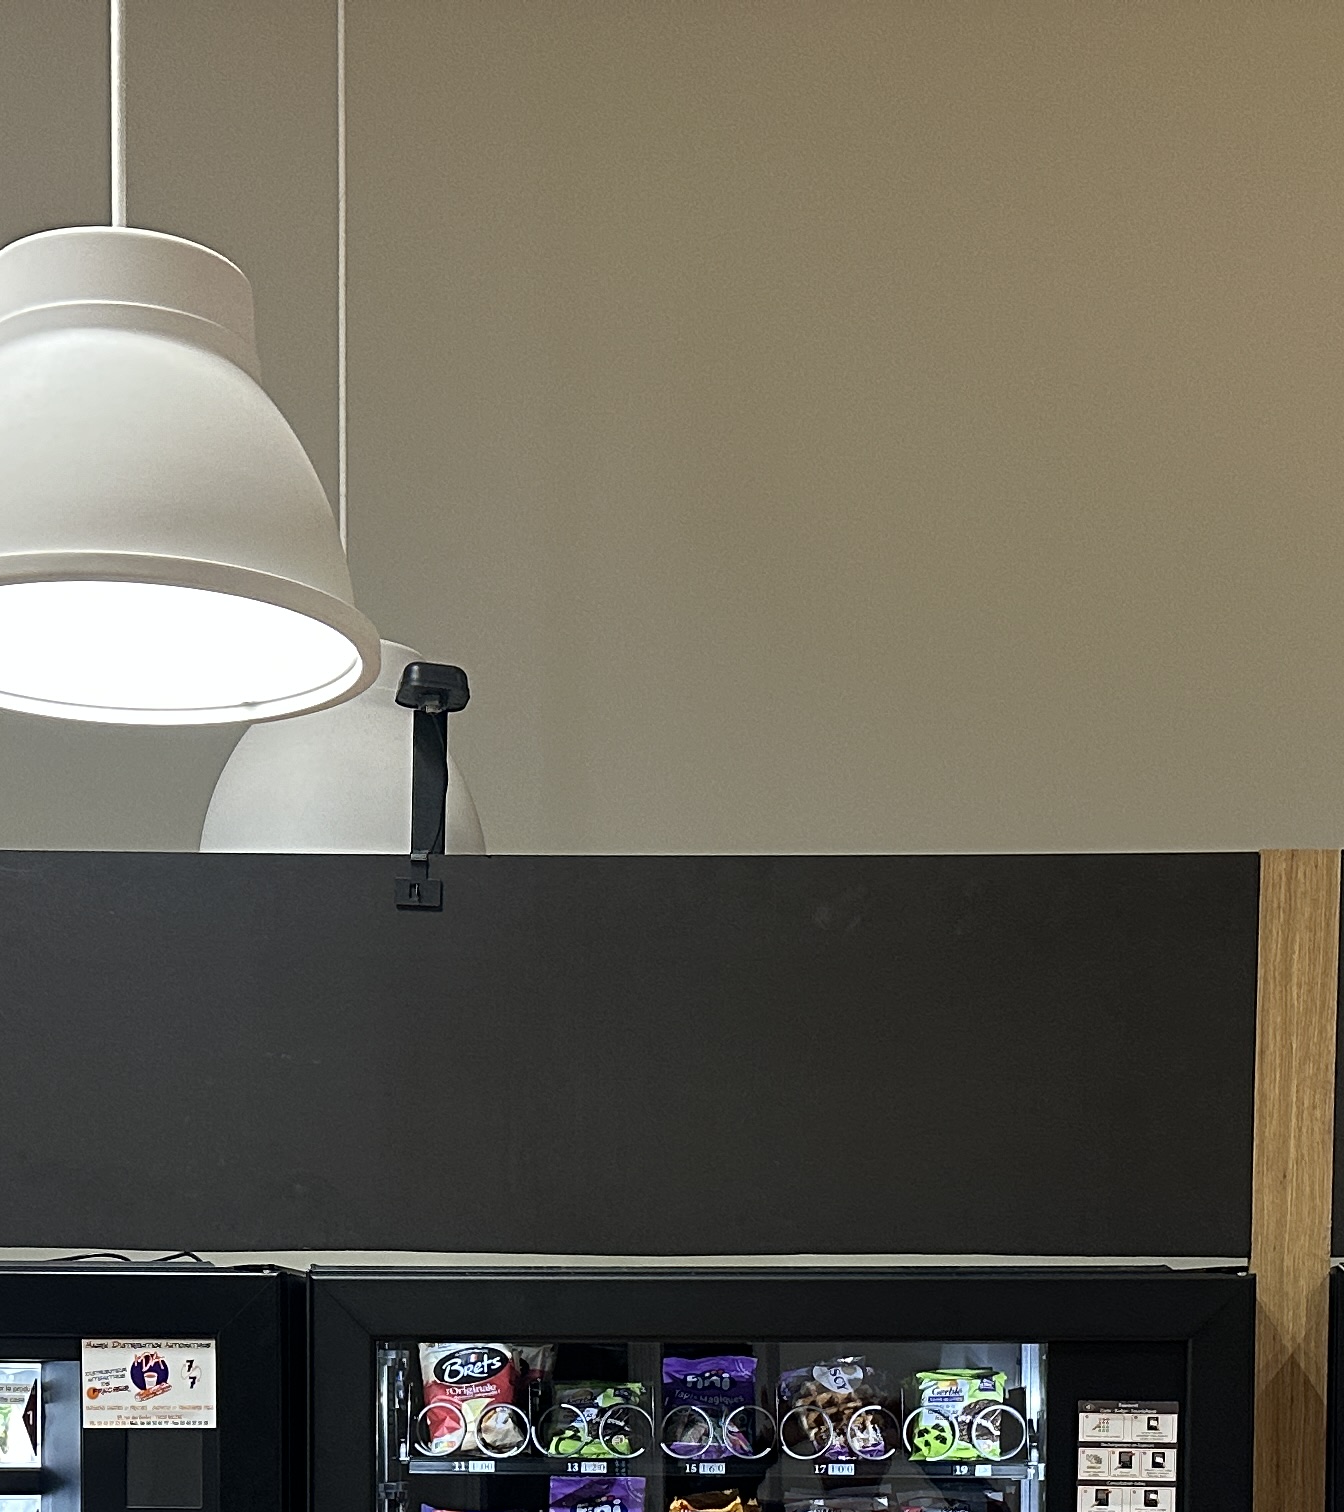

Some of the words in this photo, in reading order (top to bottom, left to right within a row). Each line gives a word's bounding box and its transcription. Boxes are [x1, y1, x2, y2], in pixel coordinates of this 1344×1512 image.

[186, 1359, 194, 1372] 7
[442, 1353, 501, 1383] Brets
[188, 1376, 196, 1389] 7
[26, 1410, 34, 1425] 1
[453, 1462, 465, 1471] 11
[567, 1462, 578, 1472] 13
[685, 1463, 697, 1473] 15
[814, 1464, 826, 1474] 17
[956, 1465, 968, 1474] 19
